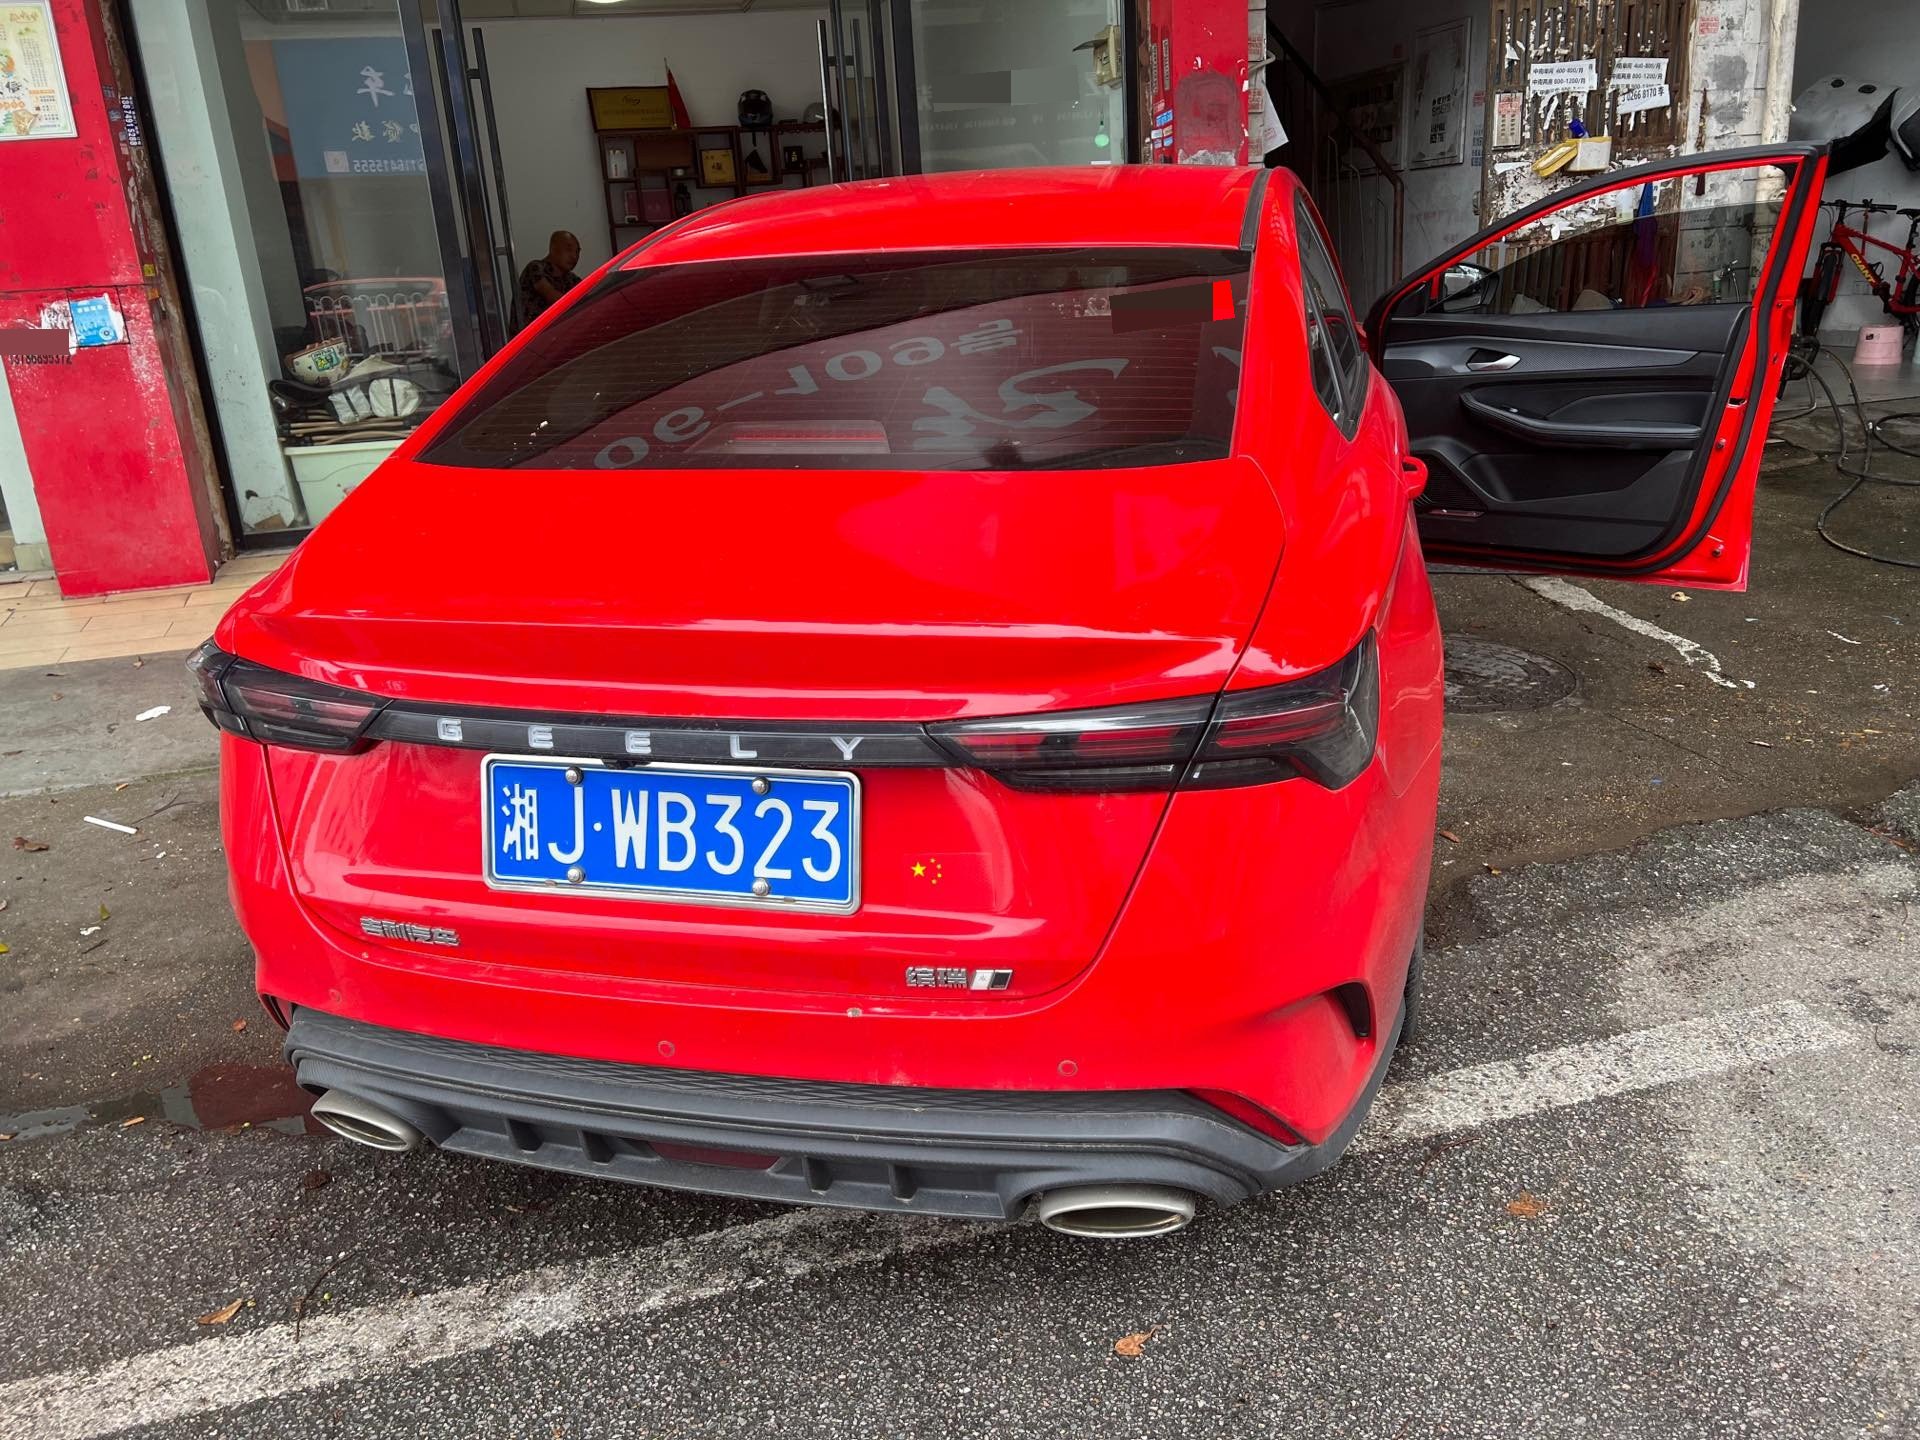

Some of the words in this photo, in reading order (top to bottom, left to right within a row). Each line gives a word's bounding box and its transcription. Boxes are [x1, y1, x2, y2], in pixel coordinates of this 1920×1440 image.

[1851, 253, 1876, 284] GIANT
[437, 717, 863, 761] GEELY
[502, 782, 842, 882] 湘J·WB323
[360, 916, 460, 947] 吉利汽车
[906, 966, 967, 989] 缤瑞
